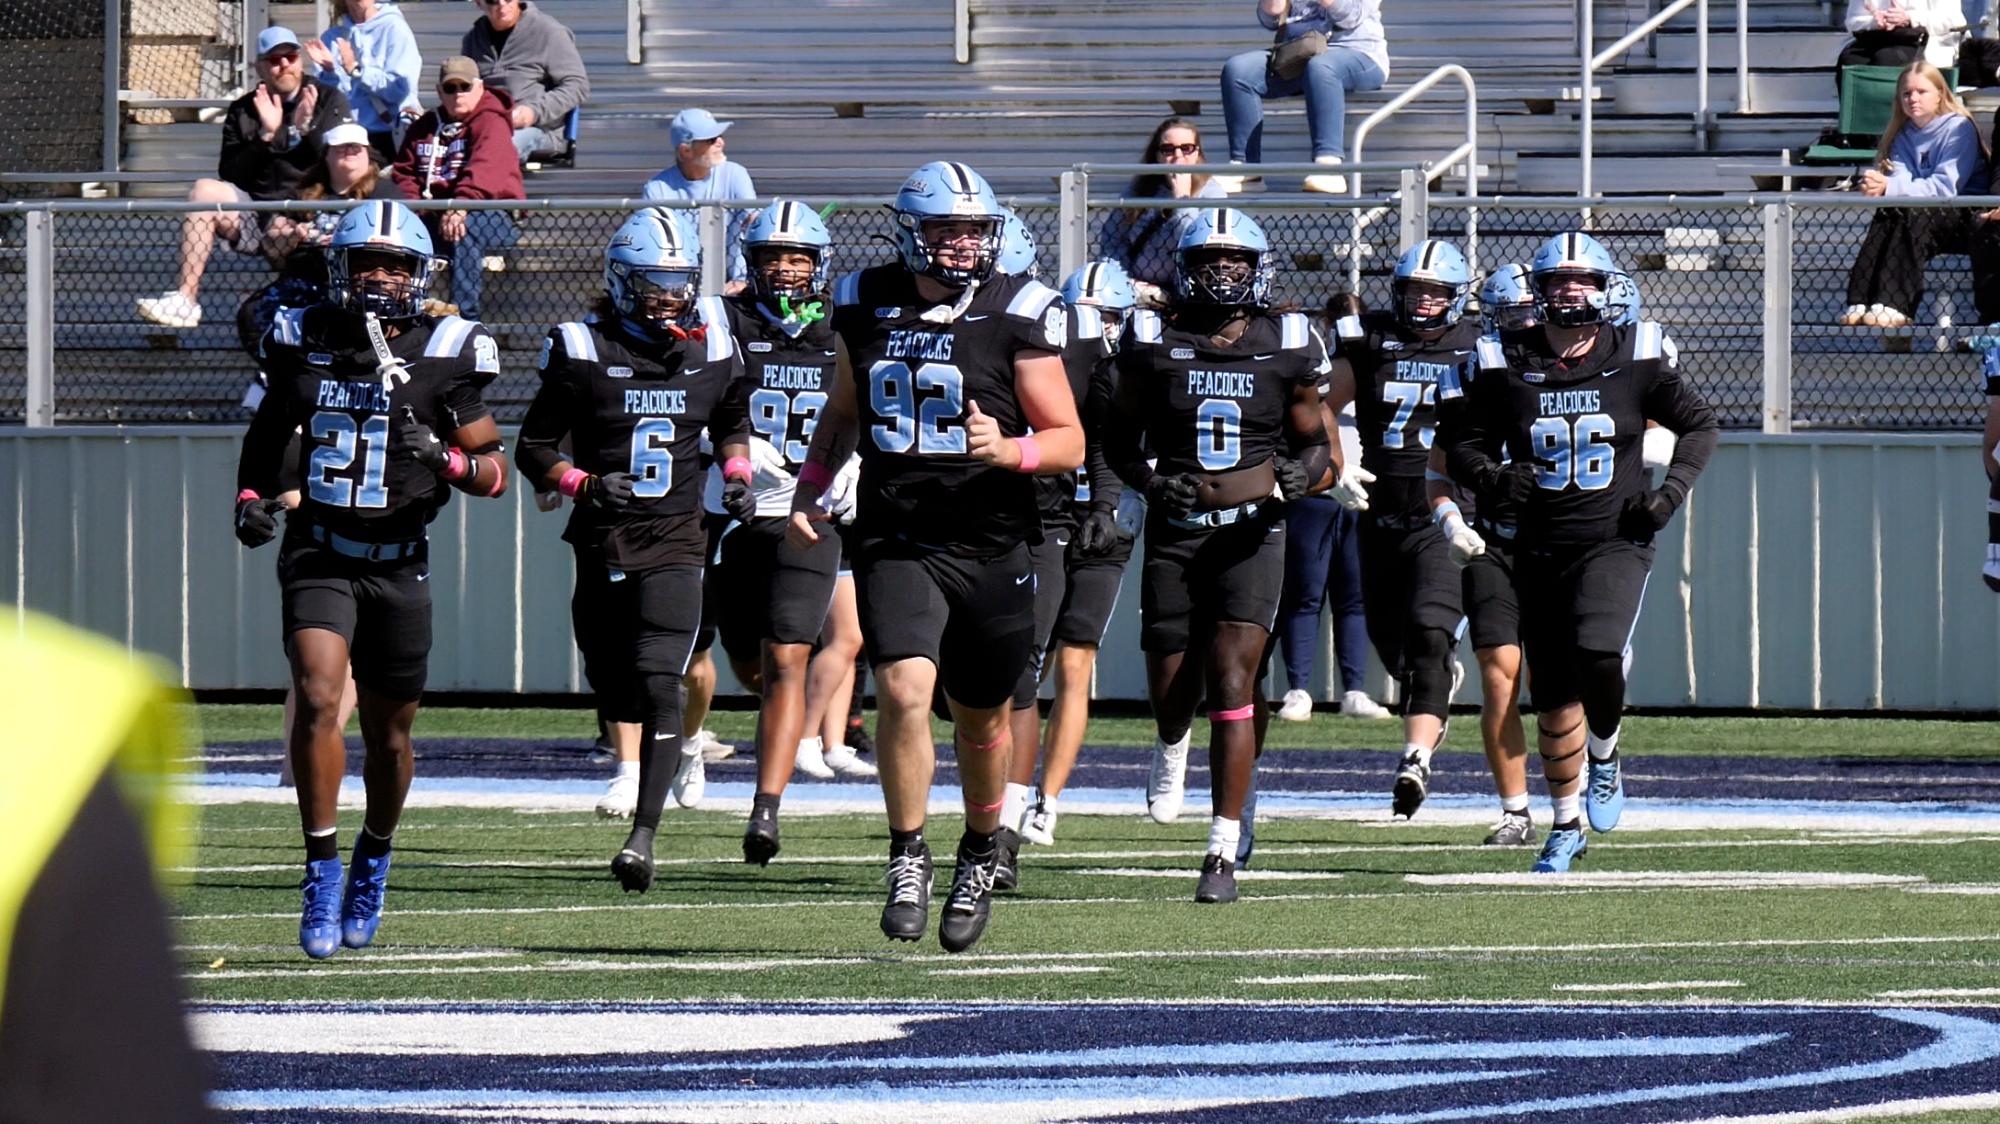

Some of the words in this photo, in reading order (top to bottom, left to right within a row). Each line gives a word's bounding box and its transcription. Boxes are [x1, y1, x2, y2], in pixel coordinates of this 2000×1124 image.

[1619, 279, 1635, 298] 35
[885, 330, 954, 360] PEACOCKS
[763, 364, 822, 390] PEACOCKS
[1187, 370, 1254, 397] PEACOCKS
[316, 379, 390, 412] PEACOCKS
[624, 389, 686, 414] PEACOCKS
[869, 360, 967, 453] 92
[1540, 389, 1601, 416] PEACOCKS
[750, 389, 829, 463] 93
[1196, 398, 1242, 470] 0
[307, 410, 389, 508] 21
[630, 416, 676, 497] 6
[1530, 413, 1616, 491] 96
